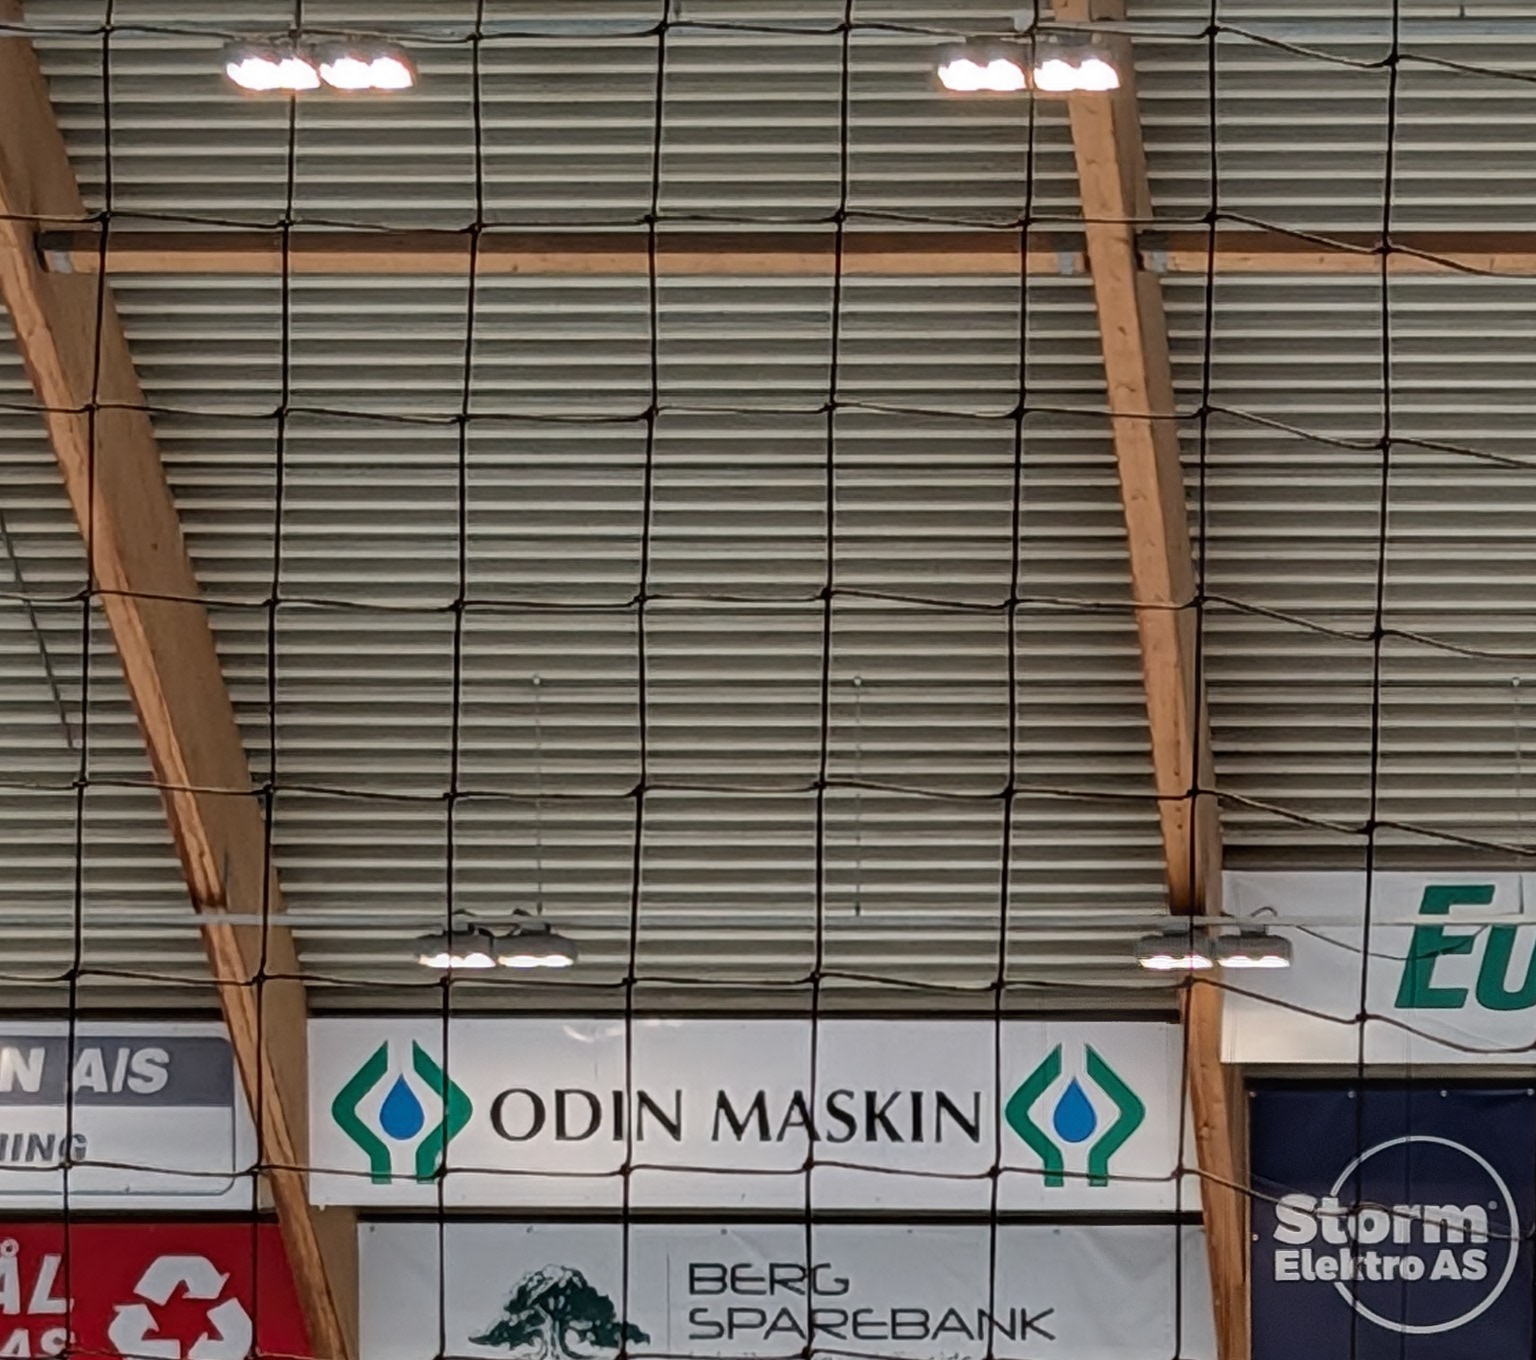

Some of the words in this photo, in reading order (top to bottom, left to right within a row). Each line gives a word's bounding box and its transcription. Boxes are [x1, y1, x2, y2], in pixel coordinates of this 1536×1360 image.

[66, 1047, 170, 1094] A/S
[489, 1087, 683, 1142] ODIN
[711, 1088, 982, 1143] MASKIN
[1273, 1193, 1489, 1244] Storm
[689, 1262, 850, 1296] BERG
[1274, 1248, 1425, 1282] Elektro
[1429, 1248, 1488, 1281] AS
[688, 1307, 1055, 1341] SPAREBANK
